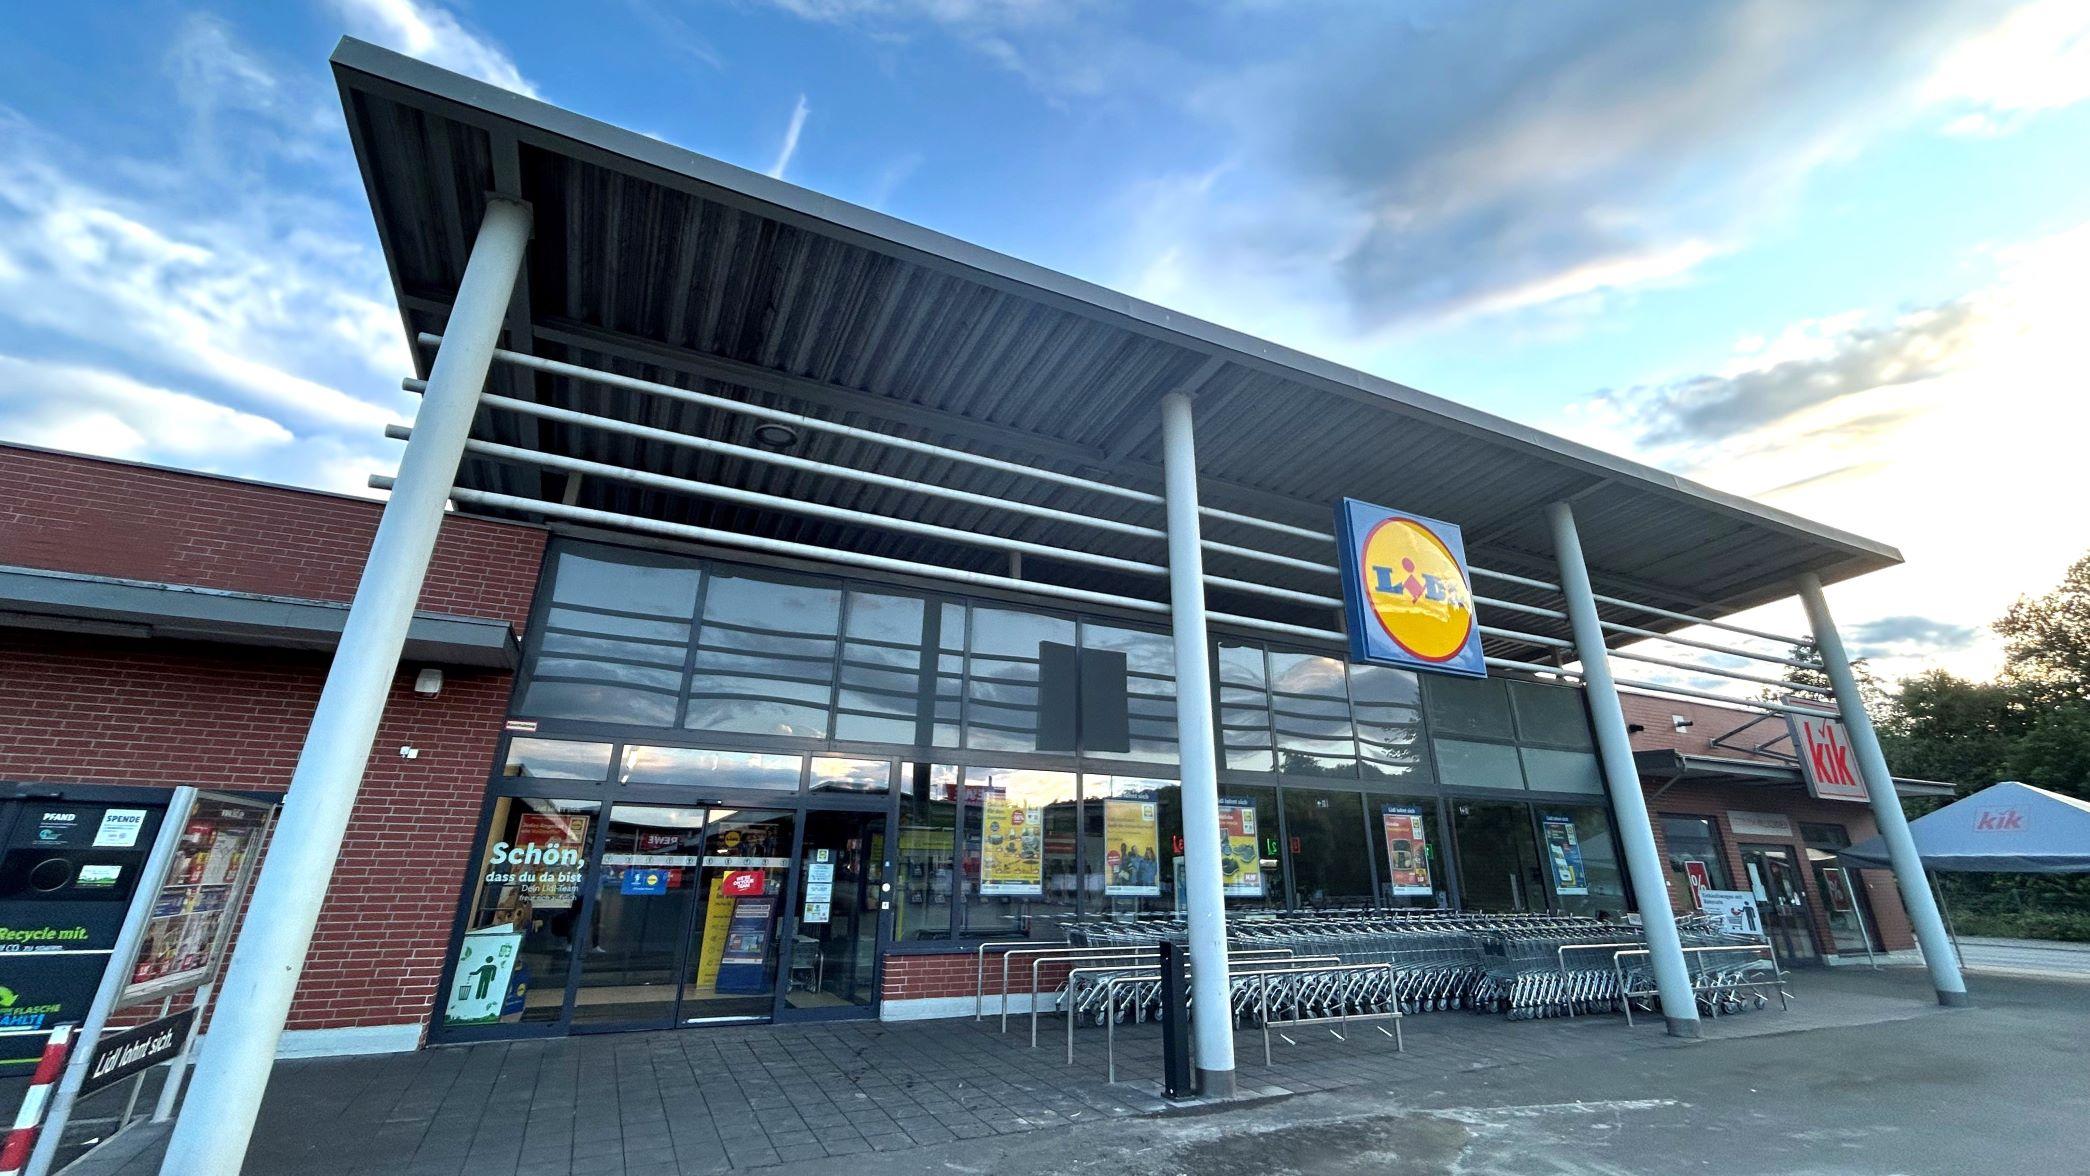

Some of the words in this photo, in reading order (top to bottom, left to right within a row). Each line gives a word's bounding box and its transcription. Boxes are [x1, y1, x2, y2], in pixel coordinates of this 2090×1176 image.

[43, 812, 76, 821] PFAND
[105, 815, 141, 823] SPENDE
[489, 841, 585, 870] Schön,
[485, 871, 516, 882] dass
[518, 871, 535, 882] du
[539, 871, 555, 882] da
[557, 871, 582, 882] bist
[521, 884, 540, 892] Dein
[0, 926, 57, 943] Recycle
[58, 926, 89, 940] mit.
[13, 1003, 62, 1015] FLASCHE
[92, 1046, 124, 1079] Lidl
[117, 1036, 152, 1068] lohnt
